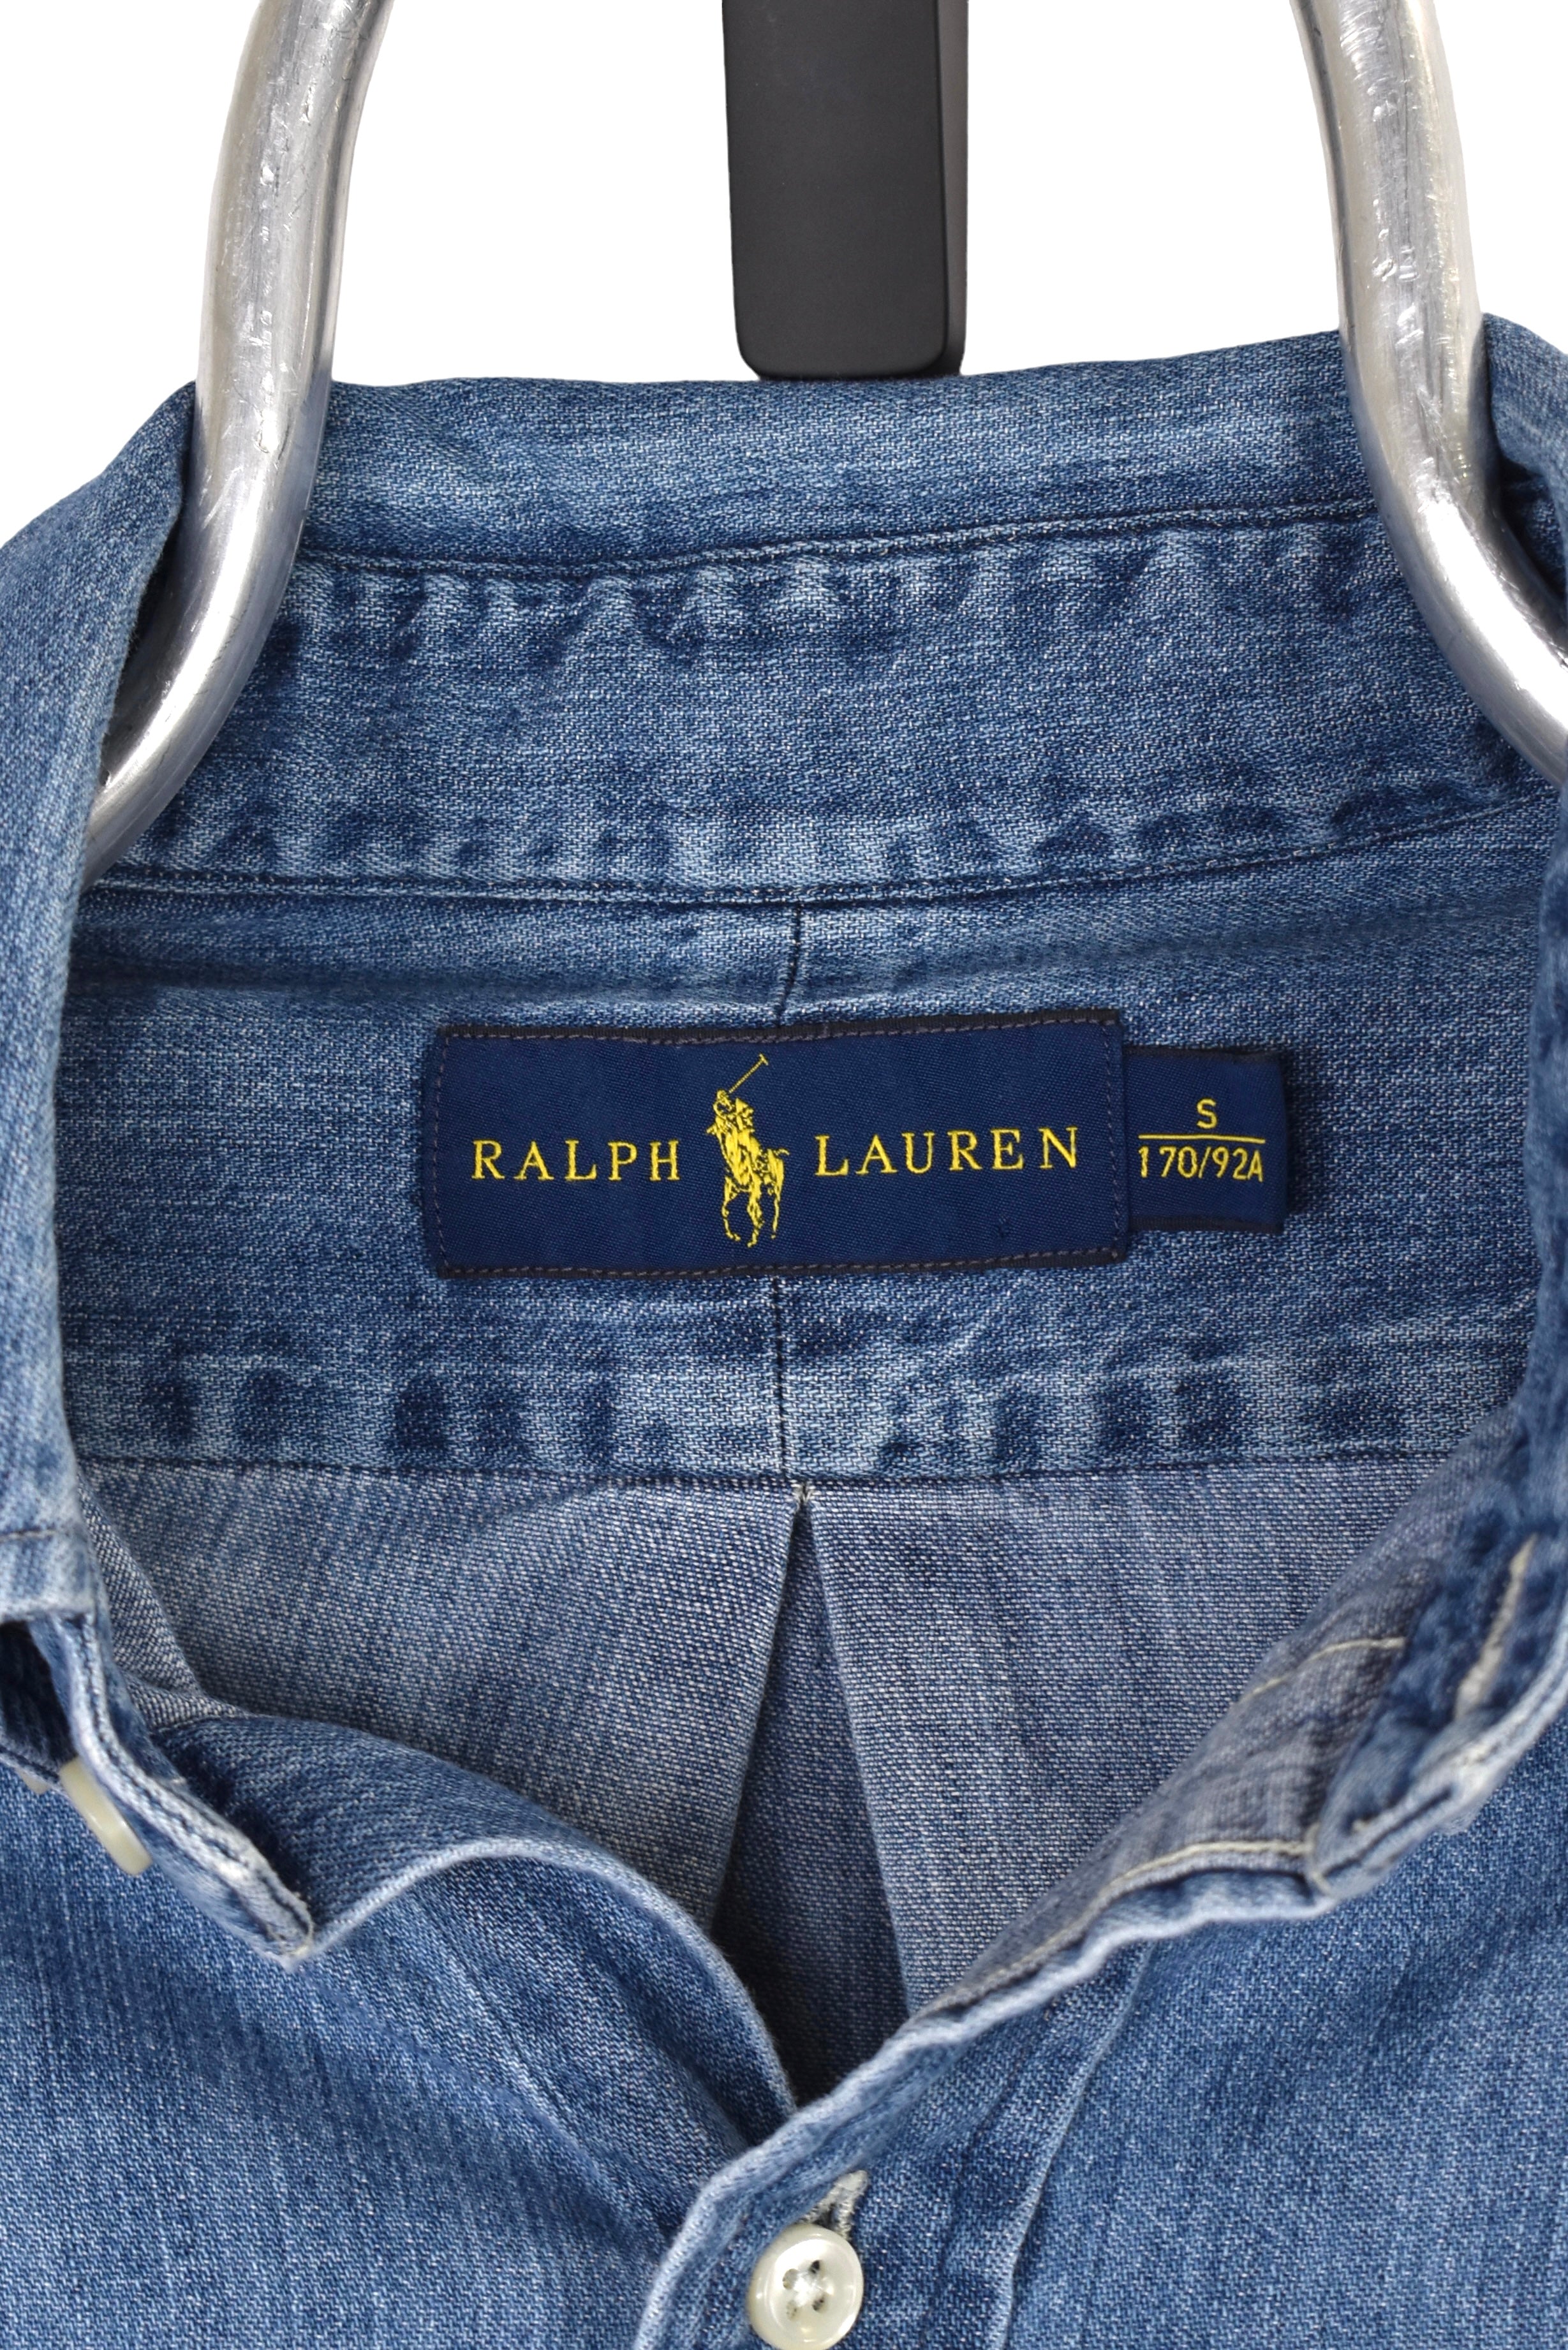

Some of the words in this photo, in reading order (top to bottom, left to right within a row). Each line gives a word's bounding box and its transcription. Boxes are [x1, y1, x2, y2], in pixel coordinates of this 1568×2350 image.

[1195, 1097, 1218, 1130] S
[471, 1139, 681, 1182] RALPH
[815, 1126, 1079, 1177] LAUREN
[1137, 1145, 1264, 1183] 170/92A
